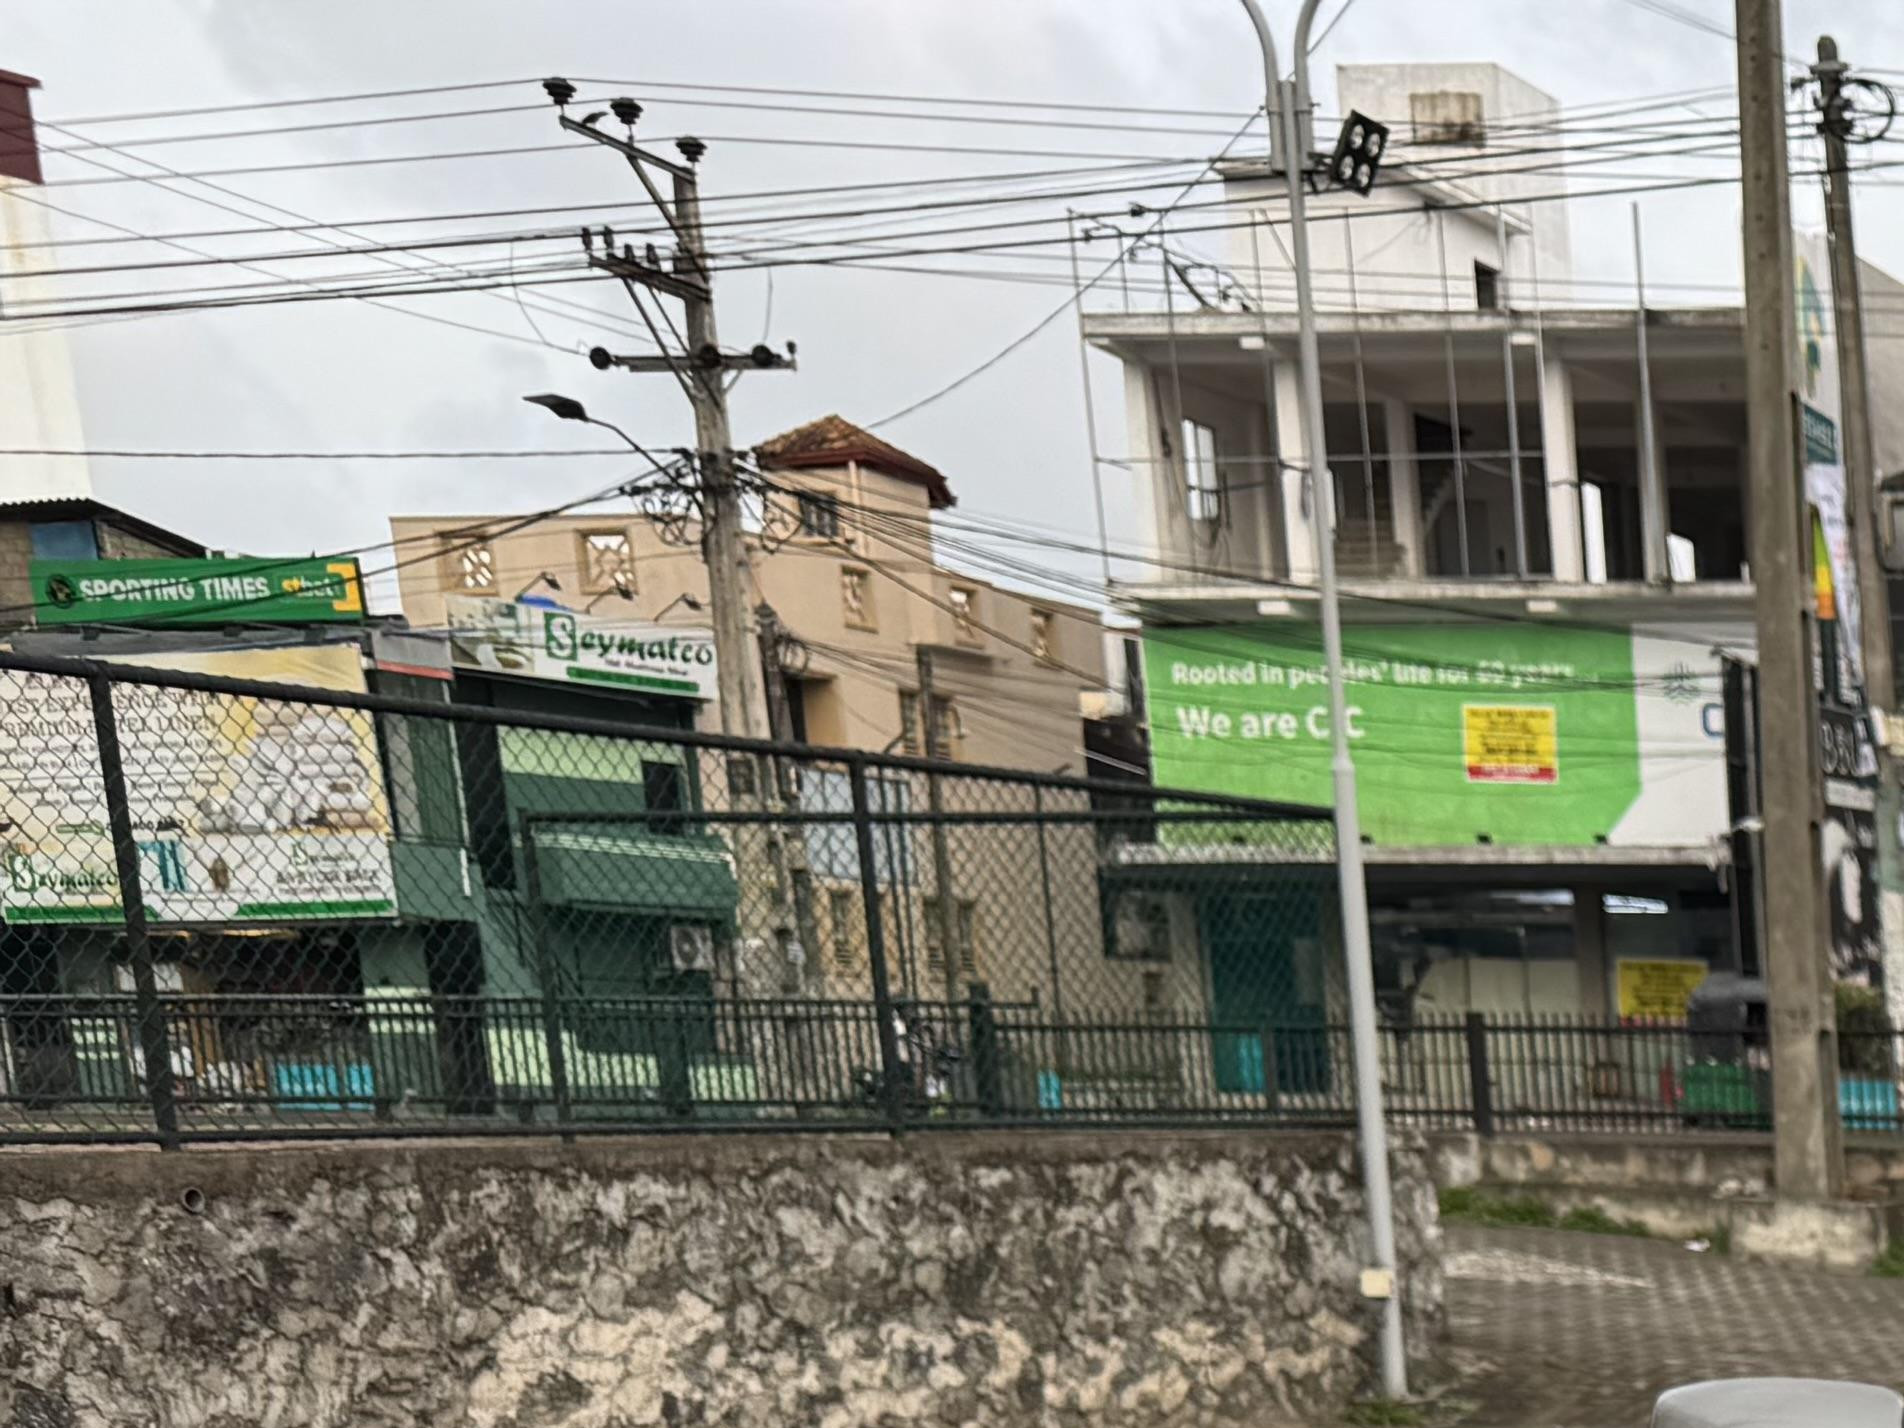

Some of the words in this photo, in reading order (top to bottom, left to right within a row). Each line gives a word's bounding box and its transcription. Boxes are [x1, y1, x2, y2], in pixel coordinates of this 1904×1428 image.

[79, 576, 195, 603] SPORTING
[202, 576, 272, 602] TIMES
[545, 612, 713, 666] Seymatco
[1171, 662, 1258, 686] Rooted
[1261, 663, 1285, 685] in
[1176, 705, 1233, 739] We
[1241, 712, 1298, 739] are
[1306, 705, 1367, 740] CC
